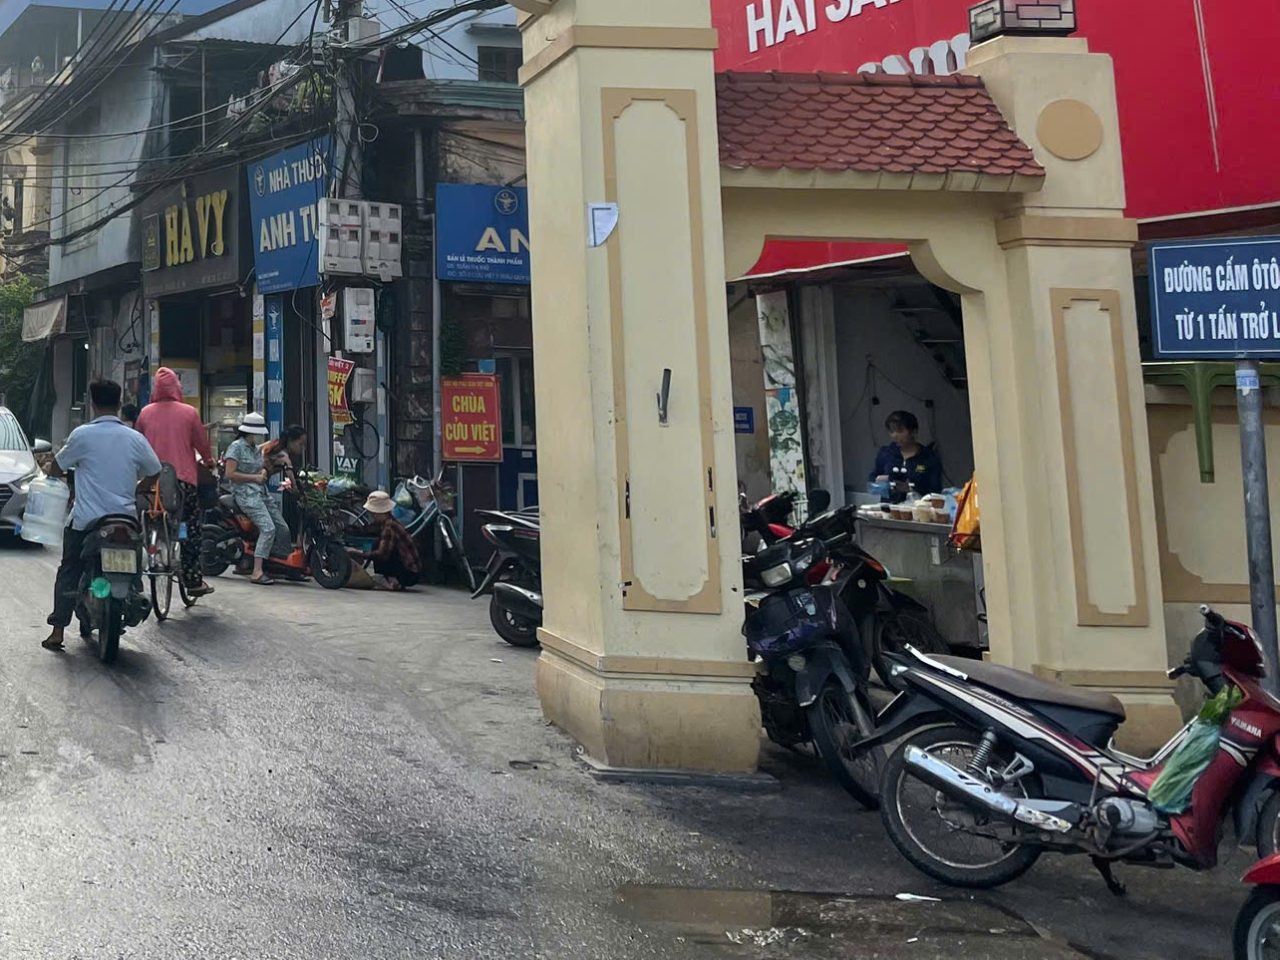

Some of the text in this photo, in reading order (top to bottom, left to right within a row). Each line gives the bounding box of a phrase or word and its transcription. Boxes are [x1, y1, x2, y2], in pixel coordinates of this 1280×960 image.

[269, 159, 291, 193] NHÀ
[196, 189, 228, 259] VY
[259, 210, 296, 253] ANH
[475, 226, 530, 254] AN
[1164, 255, 1280, 293] ĐƯỜNG CẤM ÔTÔ
[1175, 308, 1194, 340] TỪ
[1196, 314, 1205, 340] 1
[1208, 304, 1238, 340] TẤN
[1240, 301, 1269, 339] TRỞ
[452, 392, 486, 413] CHÙA
[445, 416, 496, 445] CỬU VIỆT
[336, 457, 358, 469] VAY
[1231, 716, 1262, 738] YAMAHA
